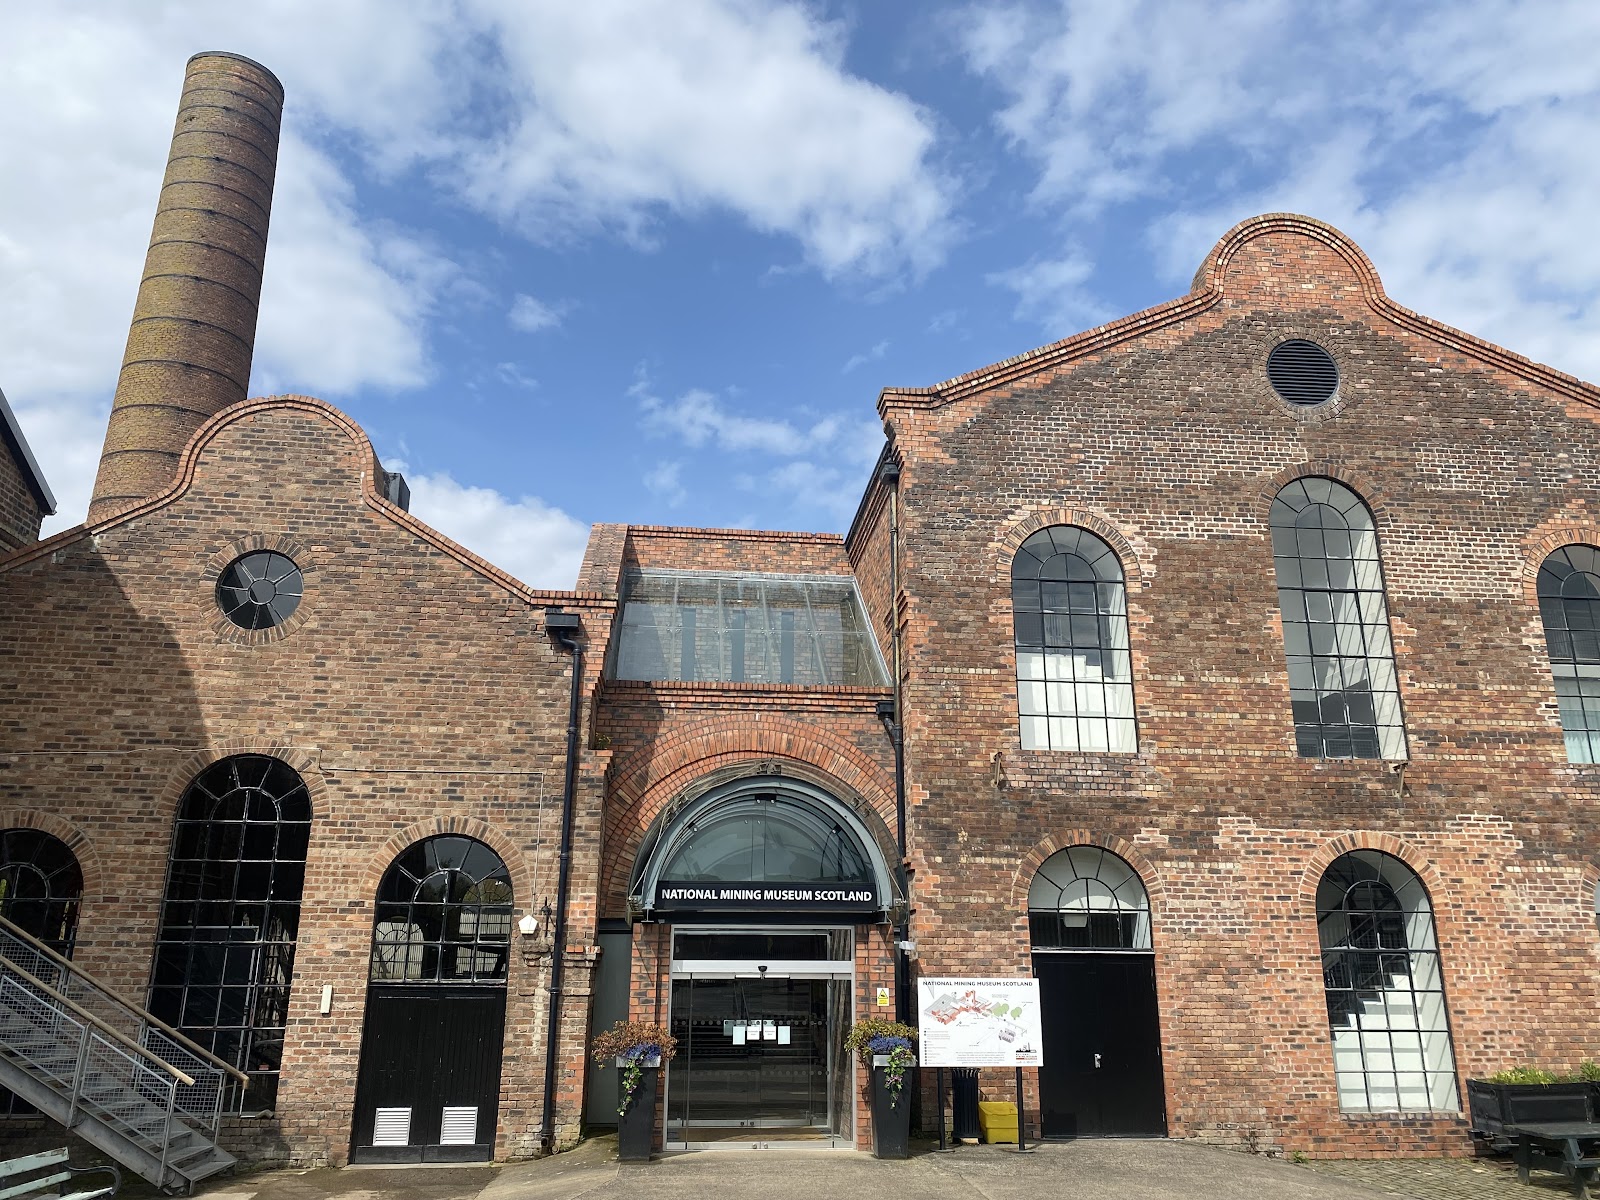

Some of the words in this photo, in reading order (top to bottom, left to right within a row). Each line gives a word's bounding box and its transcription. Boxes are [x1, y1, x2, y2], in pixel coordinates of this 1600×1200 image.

[661, 889, 718, 900] NATIONAL
[720, 890, 762, 901] MINING
[763, 890, 813, 901] MUSEUM
[814, 891, 872, 902] SCOTLAND
